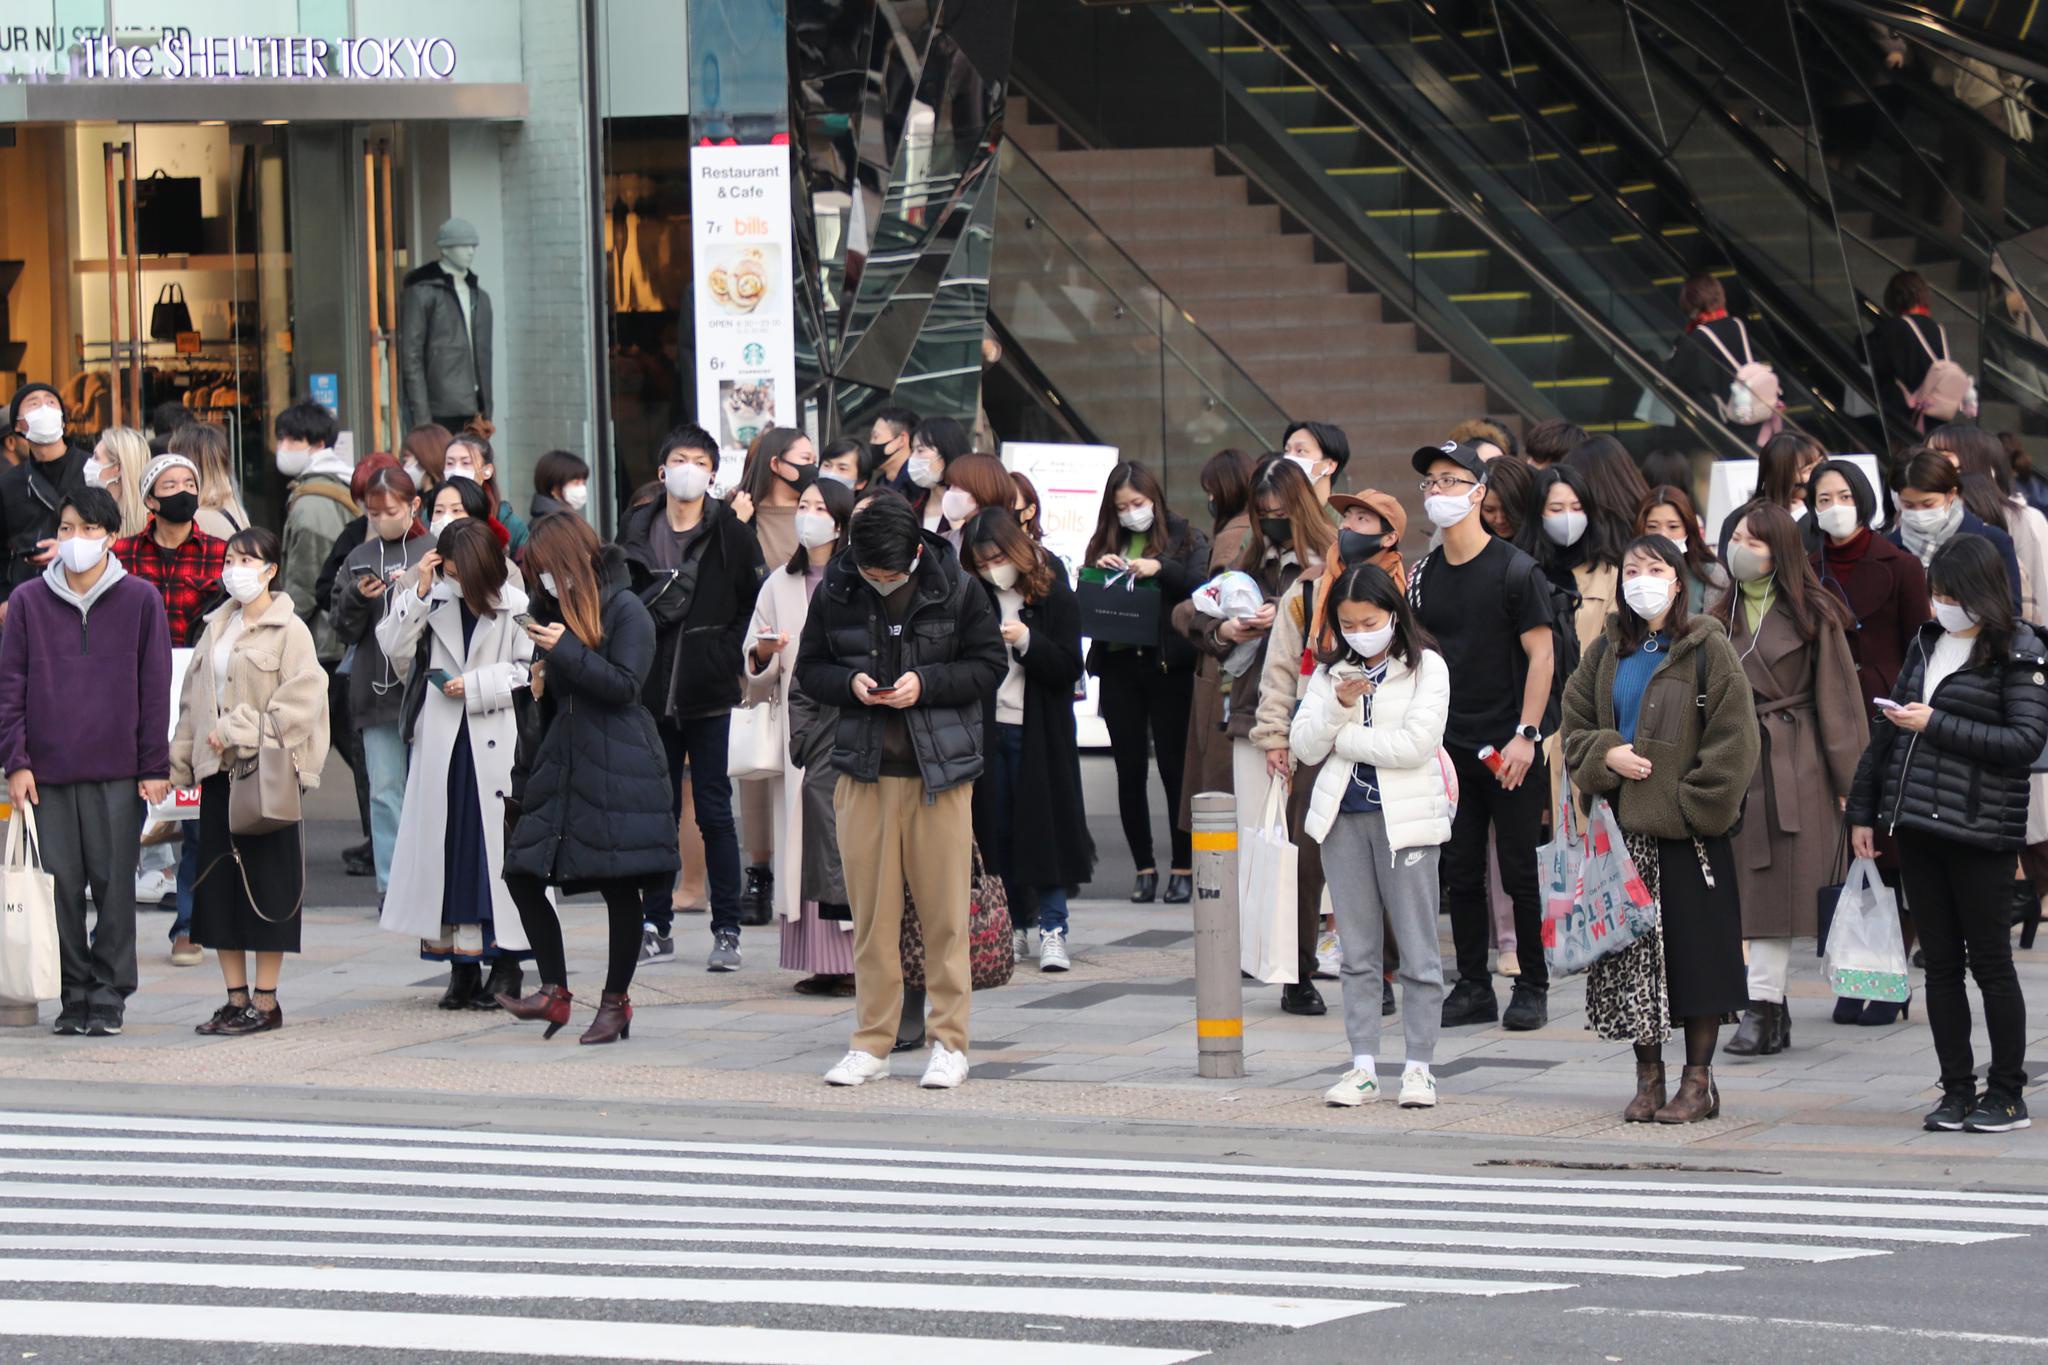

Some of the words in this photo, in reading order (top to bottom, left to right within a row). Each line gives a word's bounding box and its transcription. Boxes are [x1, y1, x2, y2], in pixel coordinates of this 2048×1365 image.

[36, 27, 64, 51] NU
[80, 34, 153, 79] The
[336, 35, 456, 79] TOKYO
[702, 166, 779, 178] Restaurant
[718, 187, 726, 199] &
[730, 186, 764, 198] Cafe
[735, 216, 768, 236] bills
[1046, 509, 1085, 532] bills
